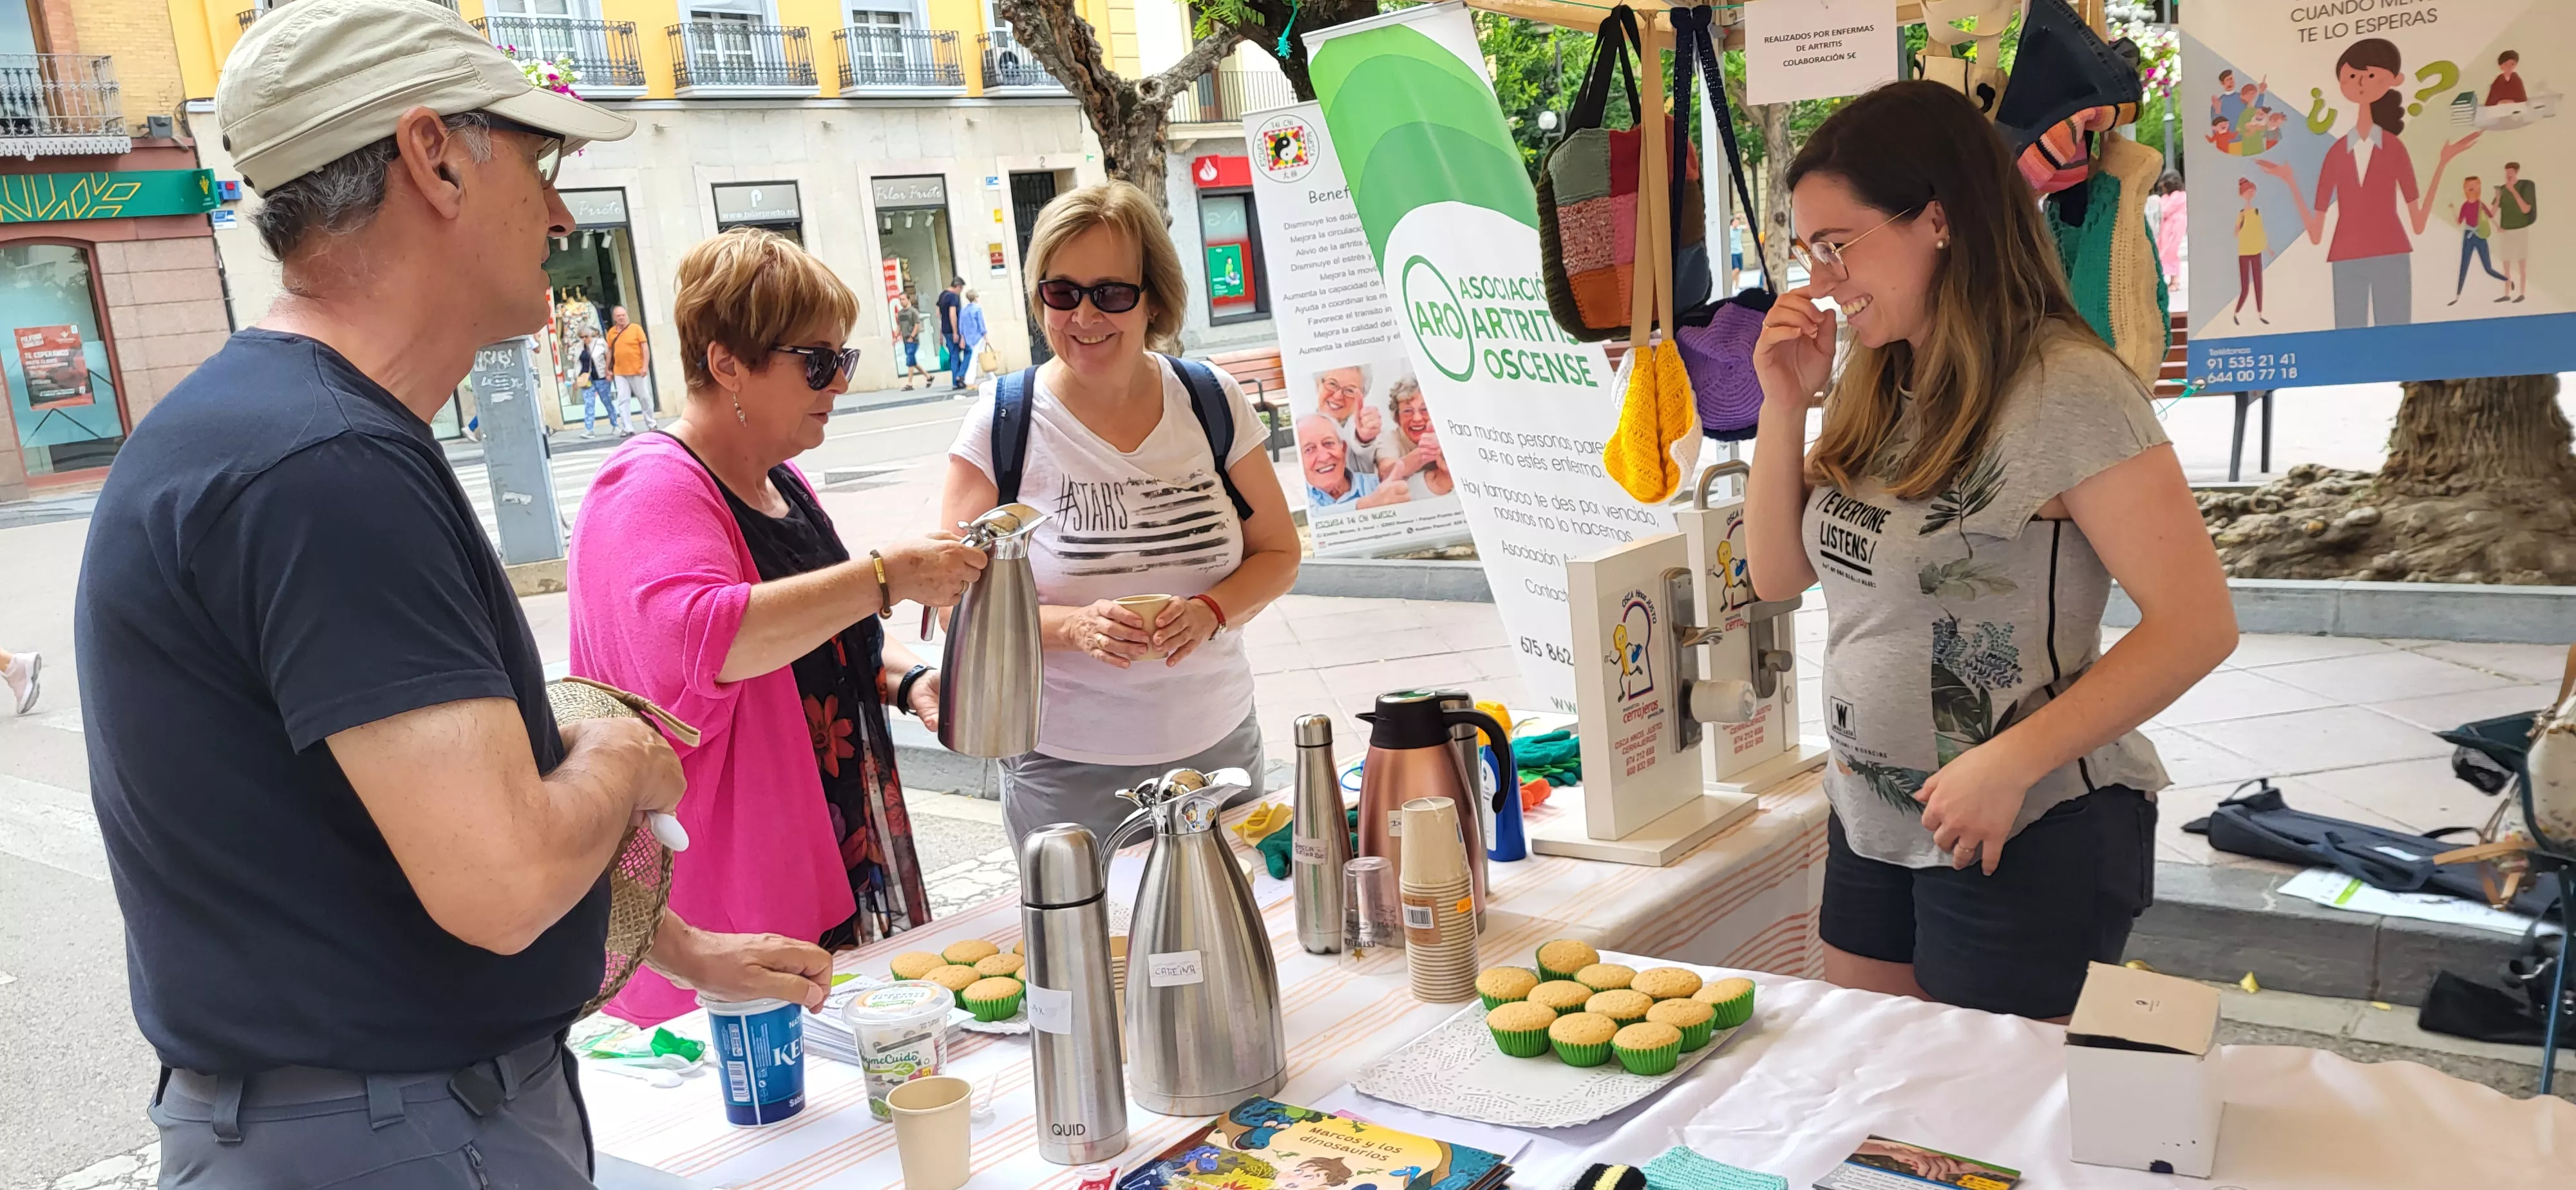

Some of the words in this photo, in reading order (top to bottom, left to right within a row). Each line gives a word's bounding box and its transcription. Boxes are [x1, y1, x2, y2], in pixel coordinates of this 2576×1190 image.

[2291, 0, 2374, 23] CUANDO
[1764, 32, 1812, 43] REALIZADOS
[1832, 24, 1875, 36] ENFERMAS
[2297, 26, 2318, 43] TE
[2324, 23, 2348, 39] LO
[2355, 8, 2438, 35] ESPERAS
[1808, 40, 1842, 50] ARTRITIS
[1783, 53, 1844, 67] COLABORACIÓN
[1039, 156, 1045, 167] 2
[1309, 185, 1350, 203] Benef
[1283, 219, 1324, 230] Disminuye
[1340, 212, 1358, 221] dolo
[1290, 234, 1317, 243] Mejora
[1327, 226, 1364, 237] circulació
[1340, 240, 1363, 249] artritis
[1291, 260, 1331, 272] Disminuye
[1320, 271, 1346, 281] Mejora
[1283, 292, 1318, 301] Aumenta
[1328, 282, 1367, 294] capacidad
[1295, 304, 1320, 314] Ayuda
[1328, 297, 1364, 308] coordinar
[1307, 315, 1343, 326] Favorece
[1415, 301, 1463, 339] ARO
[1314, 329, 1340, 339] Mejora
[1351, 323, 1378, 332] calidad
[1299, 345, 1333, 355] Aumenta
[1345, 335, 1385, 348] elasticidad
[1484, 348, 1599, 387] OSCENSE
[2207, 358, 2223, 370] 91
[2228, 355, 2255, 369] 535
[2258, 354, 2274, 366] 21
[2279, 353, 2295, 365] 41
[2207, 372, 2233, 384] 644
[2237, 370, 2255, 382] 00
[2259, 368, 2275, 380] 77
[2280, 367, 2298, 379] 18
[1448, 419, 1472, 437] Para
[1474, 424, 1514, 445] muchas
[1517, 431, 1572, 450] personas
[1479, 446, 1498, 462] que
[1500, 452, 1513, 466] no
[1517, 452, 1548, 471] estés
[1552, 455, 1605, 478] enfermo.
[1052, 473, 1128, 533] #STARS
[1461, 477, 1482, 498] Hoy
[1483, 481, 1532, 506] tampoco
[1534, 491, 1548, 507] te
[1551, 495, 1576, 511] des
[1579, 498, 1600, 516] por
[1602, 505, 1660, 528] vencido,
[1494, 505, 1537, 527] nosotros
[1539, 516, 1555, 529] no
[1556, 515, 1569, 533] lo
[1502, 540, 1560, 567] Asociación
[1525, 578, 1569, 602] Contact
[1520, 636, 1542, 657] 675
[1546, 642, 1575, 666] 862
[1550, 696, 1577, 713] ww
[1615, 737, 1629, 750] OSCA
[1646, 722, 1663, 735] JUSTO
[1052, 1123, 1086, 1137] QUID
[1299, 1135, 1389, 1162] dinosaurios
[1308, 1127, 1363, 1143] Marcos
[1365, 1138, 1377, 1148] y
[1378, 1141, 1403, 1154] los
